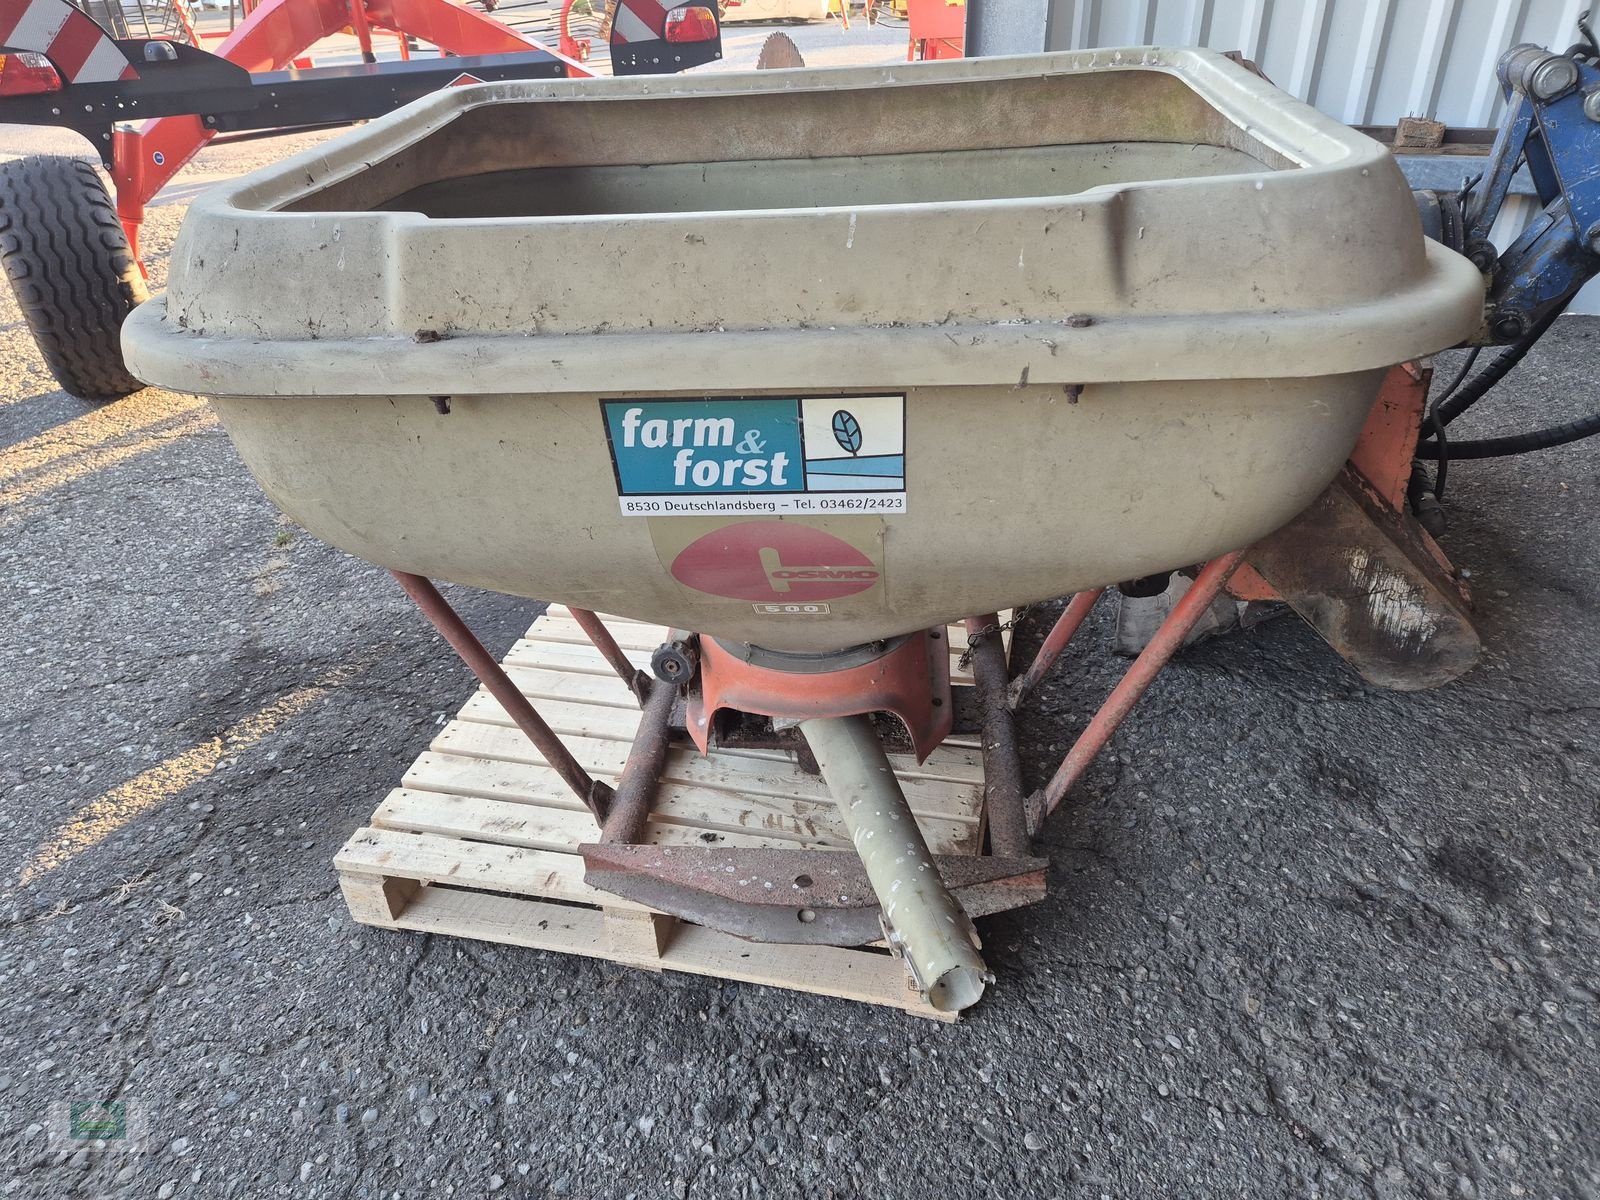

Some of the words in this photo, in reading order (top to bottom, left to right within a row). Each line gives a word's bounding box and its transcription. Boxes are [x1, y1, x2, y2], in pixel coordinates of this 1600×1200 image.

[622, 408, 735, 448] farm
[735, 429, 767, 454] &
[673, 449, 789, 487] forst
[626, 501, 660, 512] 8530
[664, 500, 776, 512] Deutschlandsberg
[794, 499, 816, 509] Tel.
[820, 497, 903, 509] 03462/2423
[765, 605, 819, 613] 500
